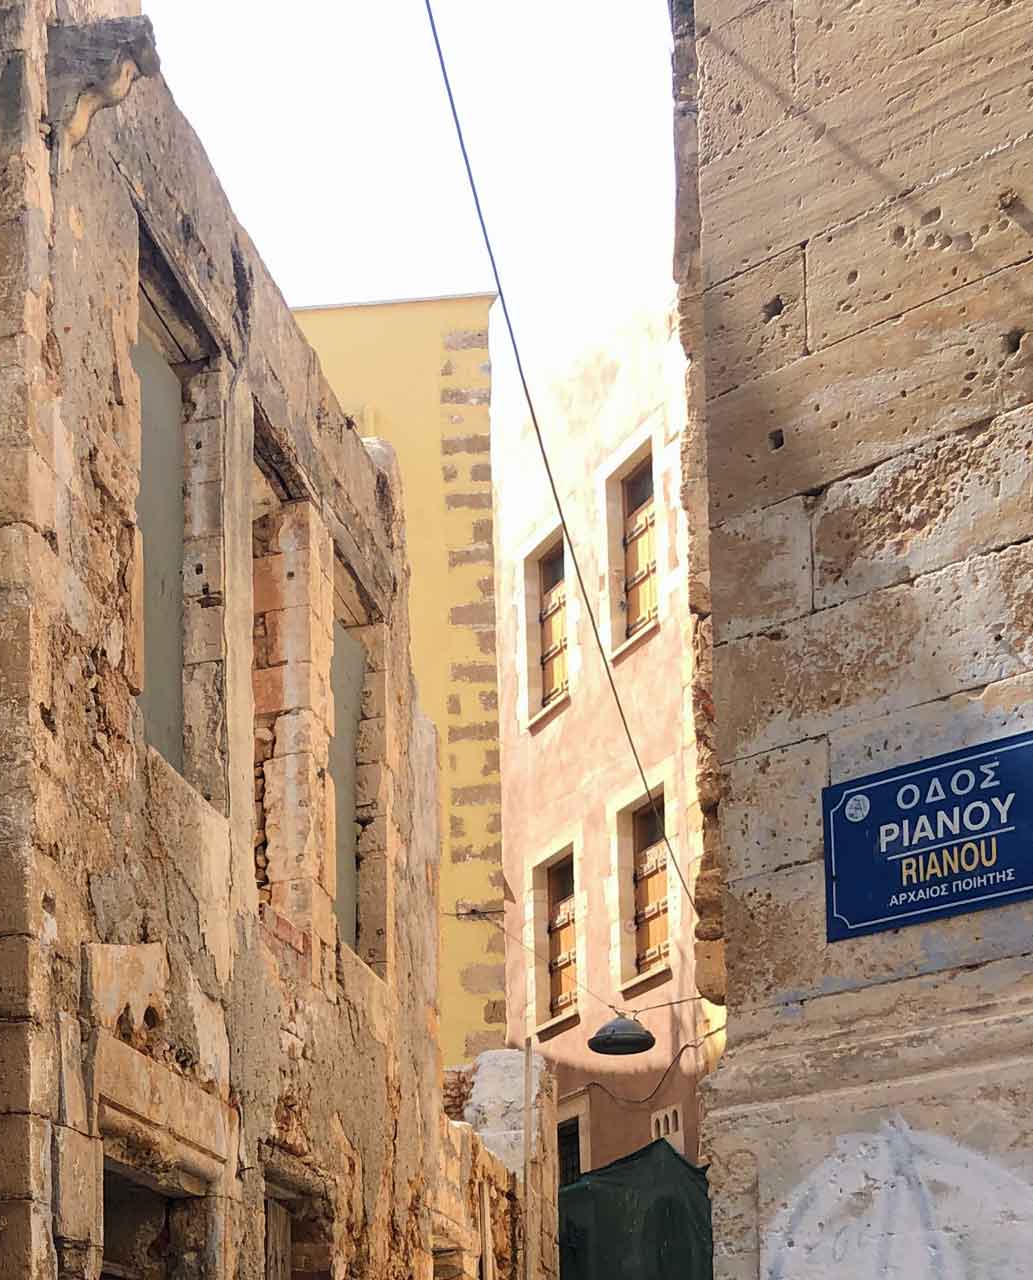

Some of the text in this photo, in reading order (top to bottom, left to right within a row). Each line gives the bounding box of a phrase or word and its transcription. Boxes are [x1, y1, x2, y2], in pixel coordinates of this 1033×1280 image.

[896, 761, 1001, 809] ΟΔΟΣ
[879, 793, 1016, 852] ΡΙΑΝΟΥ
[901, 837, 997, 887] RIANOU
[889, 868, 1016, 907] ΑΡΧΑΙΟΣ ΠΟΙΗΤΗΣ
